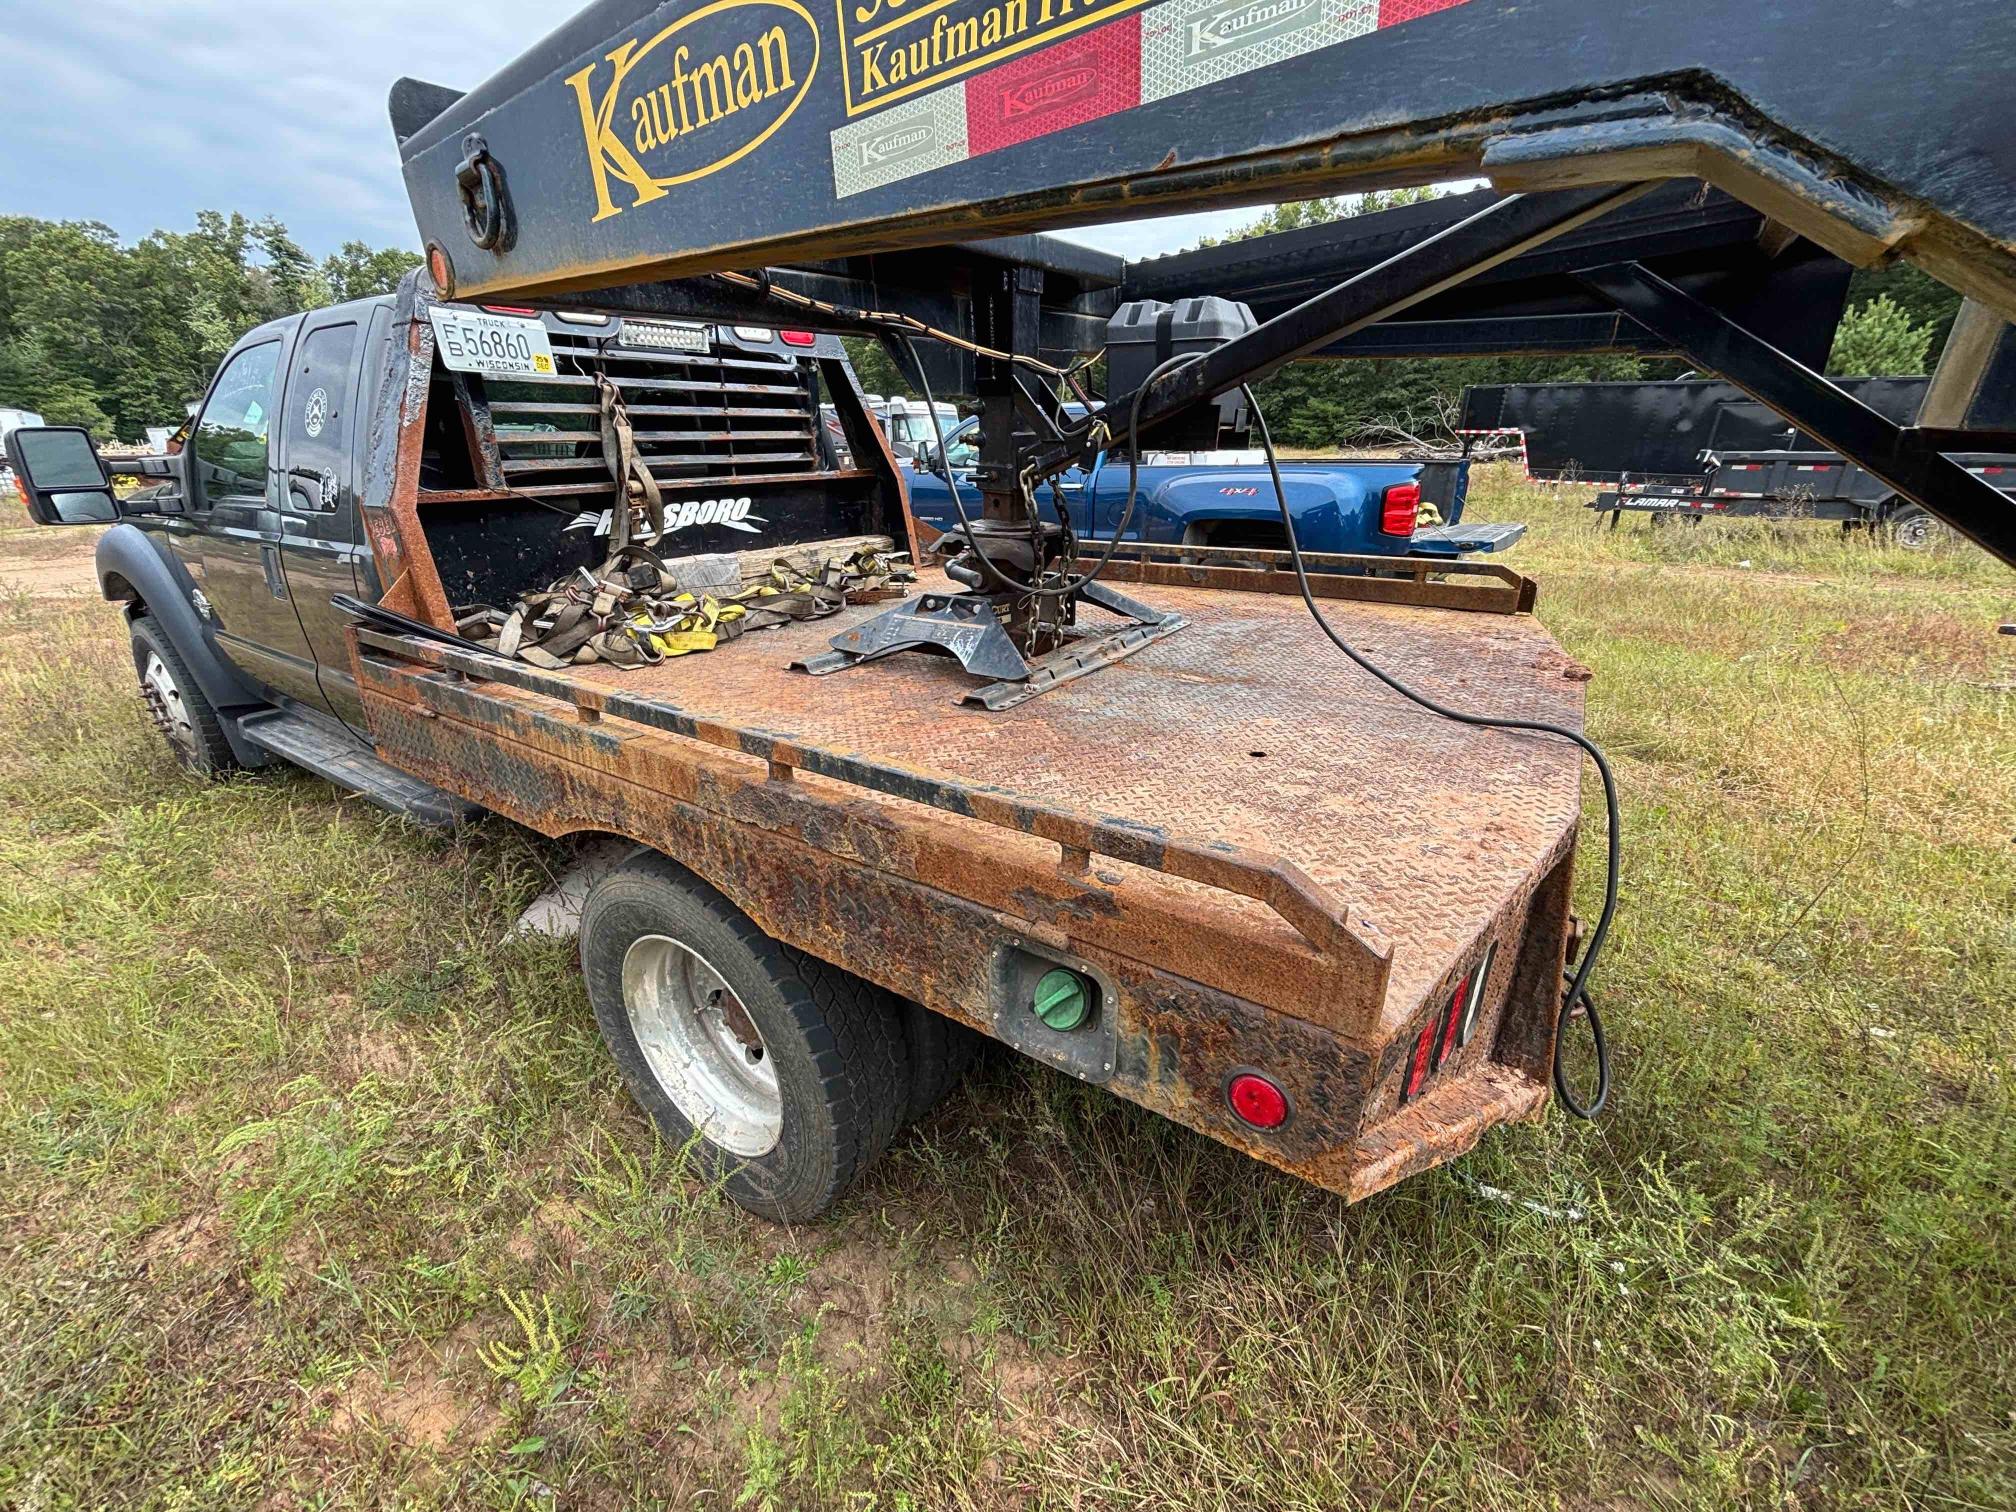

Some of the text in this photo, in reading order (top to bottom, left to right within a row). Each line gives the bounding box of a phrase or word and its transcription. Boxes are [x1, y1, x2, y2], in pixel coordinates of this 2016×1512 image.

[860, 0, 1028, 96] Kaufman
[1000, 72, 1089, 118] Kaufman
[564, 25, 796, 222] Kaufman
[859, 126, 927, 166] Kaufman
[476, 317, 505, 328] TRUCK
[462, 327, 531, 361] 56860
[476, 359, 530, 371] WISCONSIN
[593, 497, 751, 537] HSBORO
[1624, 497, 1679, 508] LAMAR
